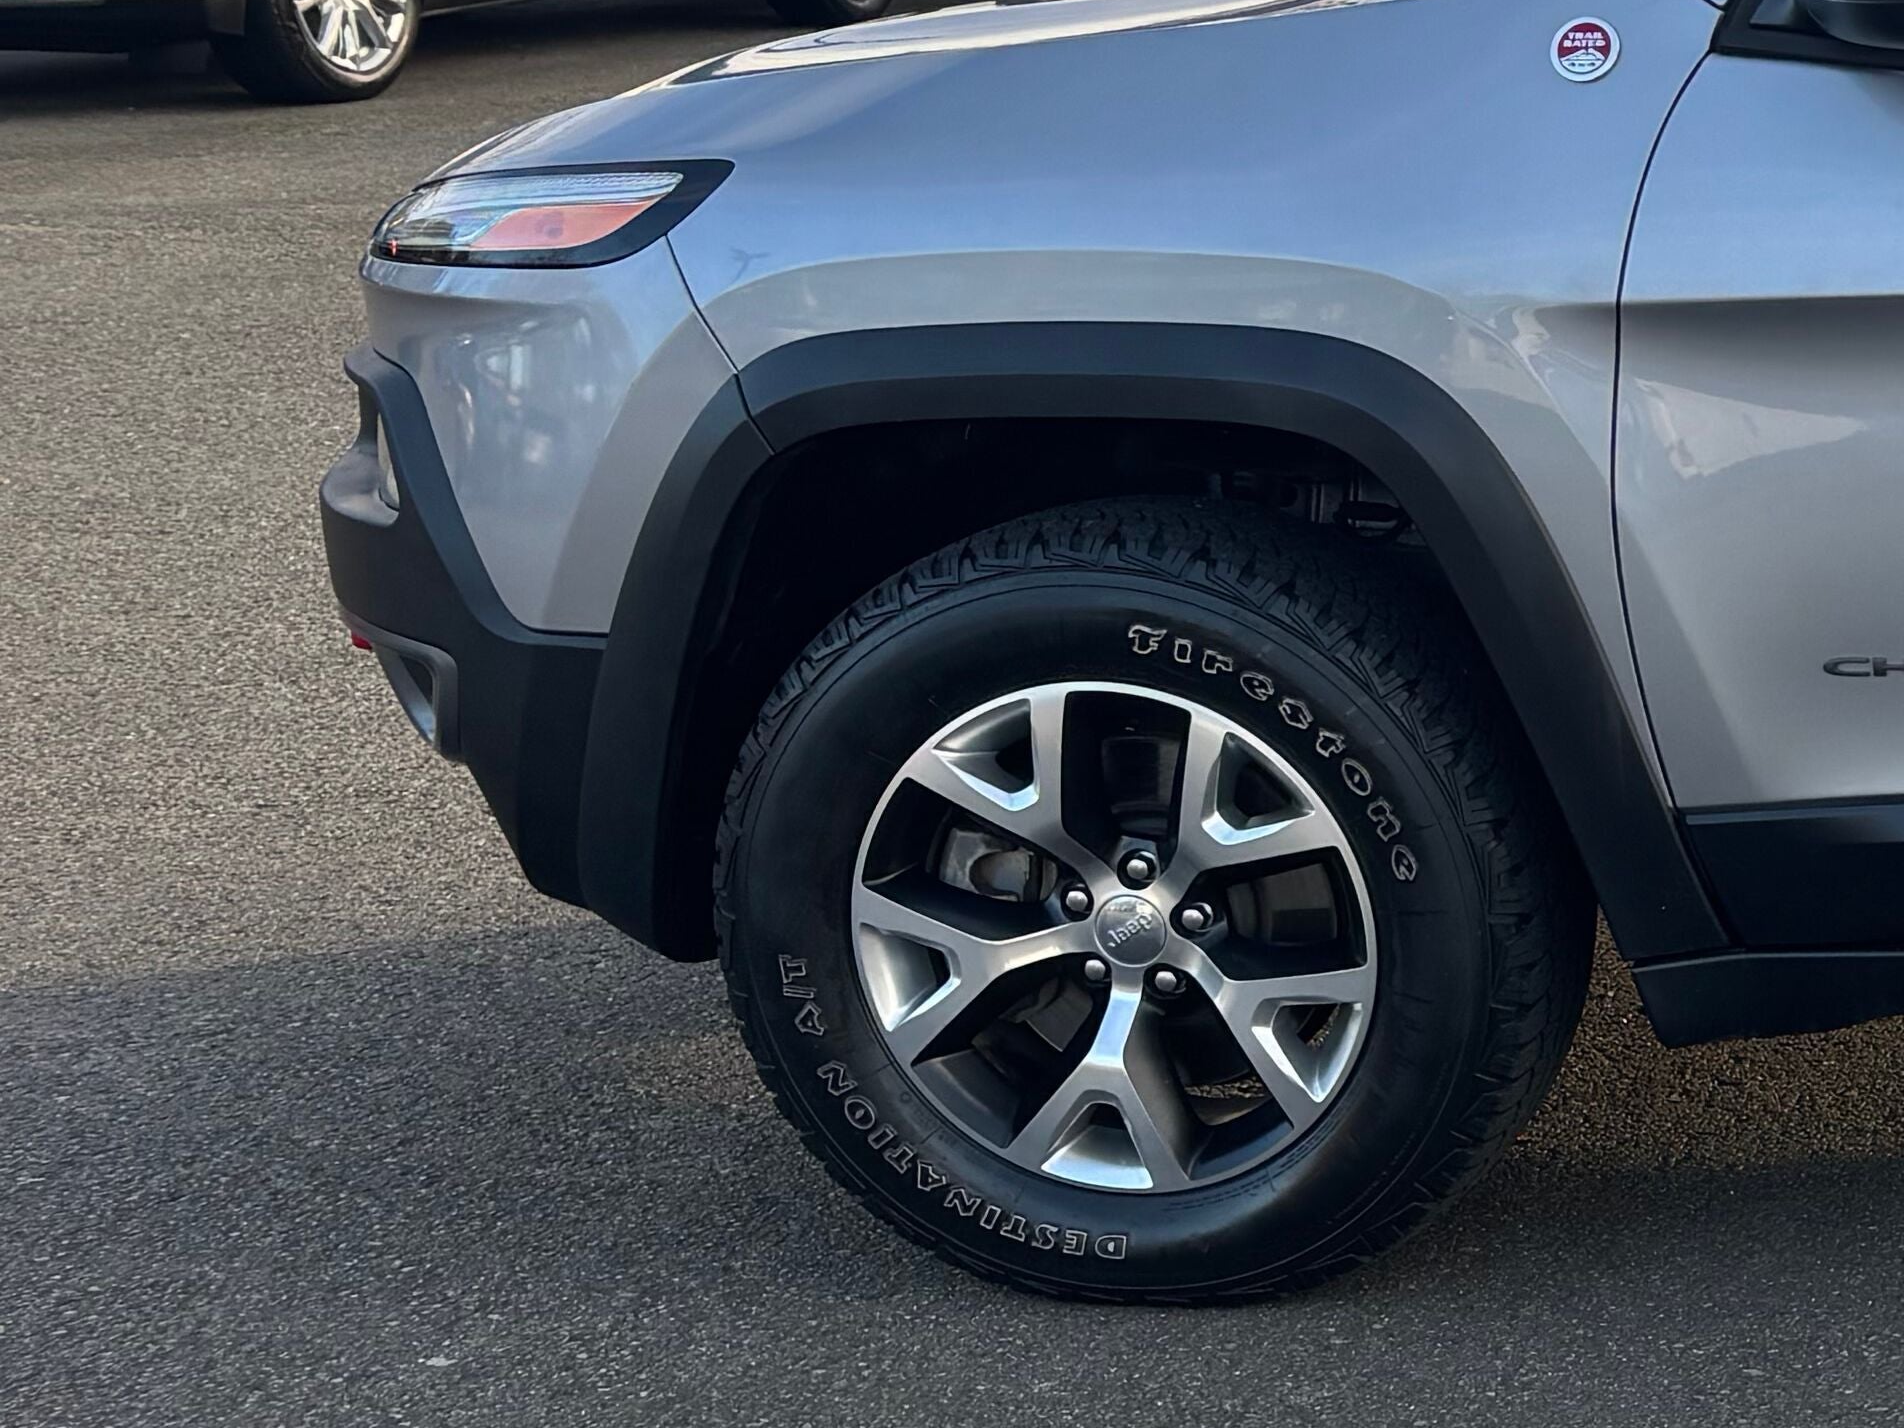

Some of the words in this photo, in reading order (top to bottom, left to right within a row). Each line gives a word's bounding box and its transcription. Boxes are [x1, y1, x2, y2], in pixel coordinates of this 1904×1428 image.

[1563, 39, 1606, 48] RATED
[1567, 31, 1604, 40] TRAIL
[1128, 624, 1417, 882] Firestone
[1107, 913, 1153, 948] Jeep
[778, 953, 825, 1036] A/T
[816, 1059, 1127, 1260] DESTINATION
